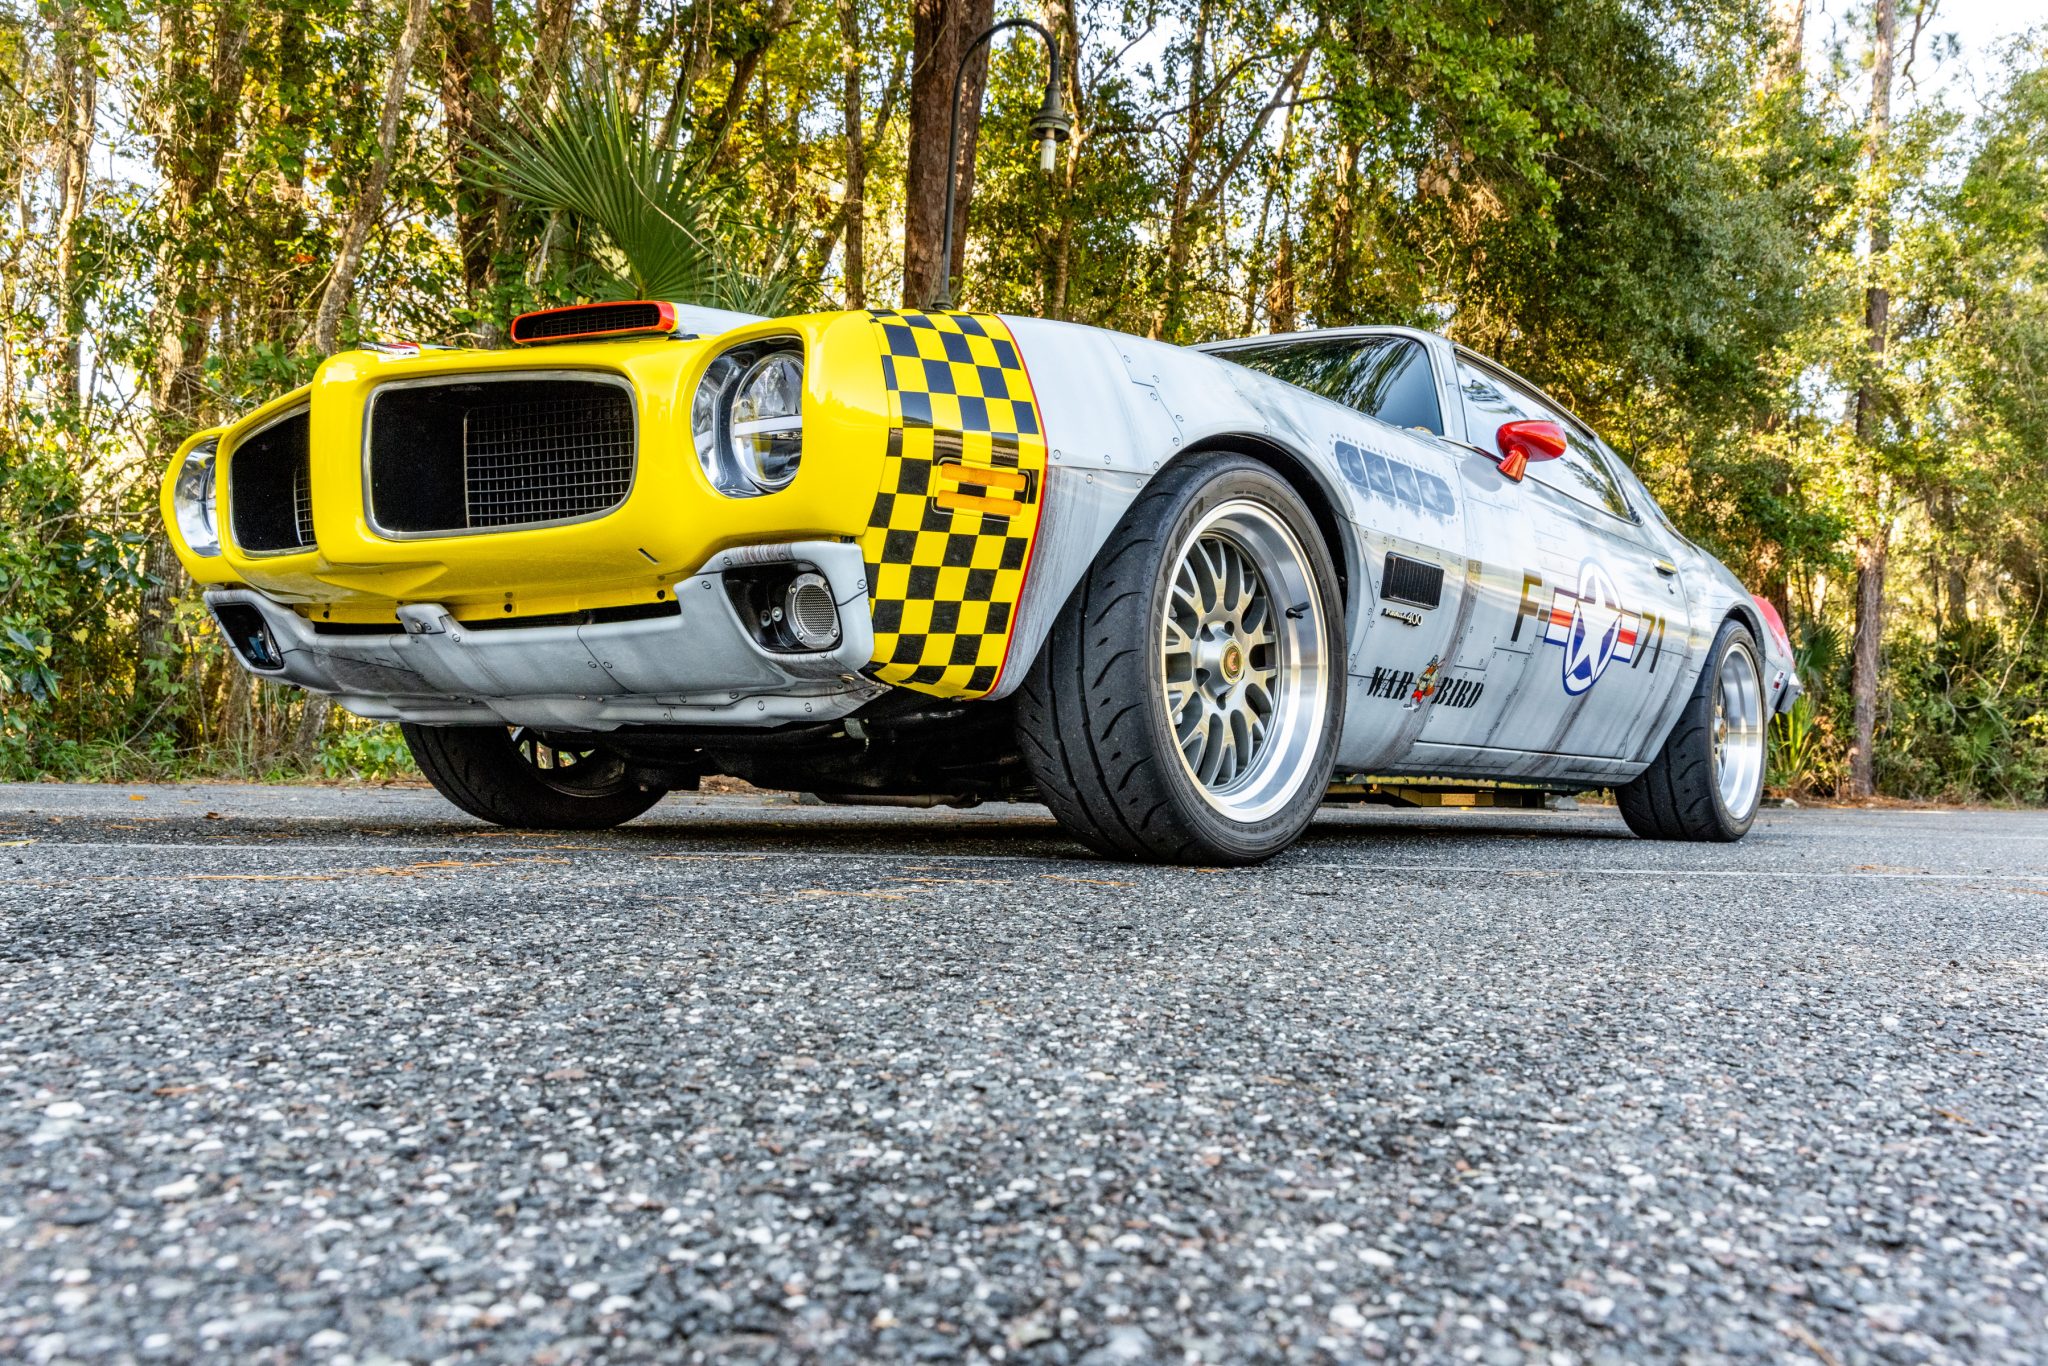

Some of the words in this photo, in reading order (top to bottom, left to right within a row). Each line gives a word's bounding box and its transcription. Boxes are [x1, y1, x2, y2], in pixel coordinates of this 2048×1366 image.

[1407, 611, 1424, 626] 400
[1632, 609, 1665, 673] 71
[1367, 665, 1414, 701] WAR
[1430, 676, 1484, 709] BIRD
